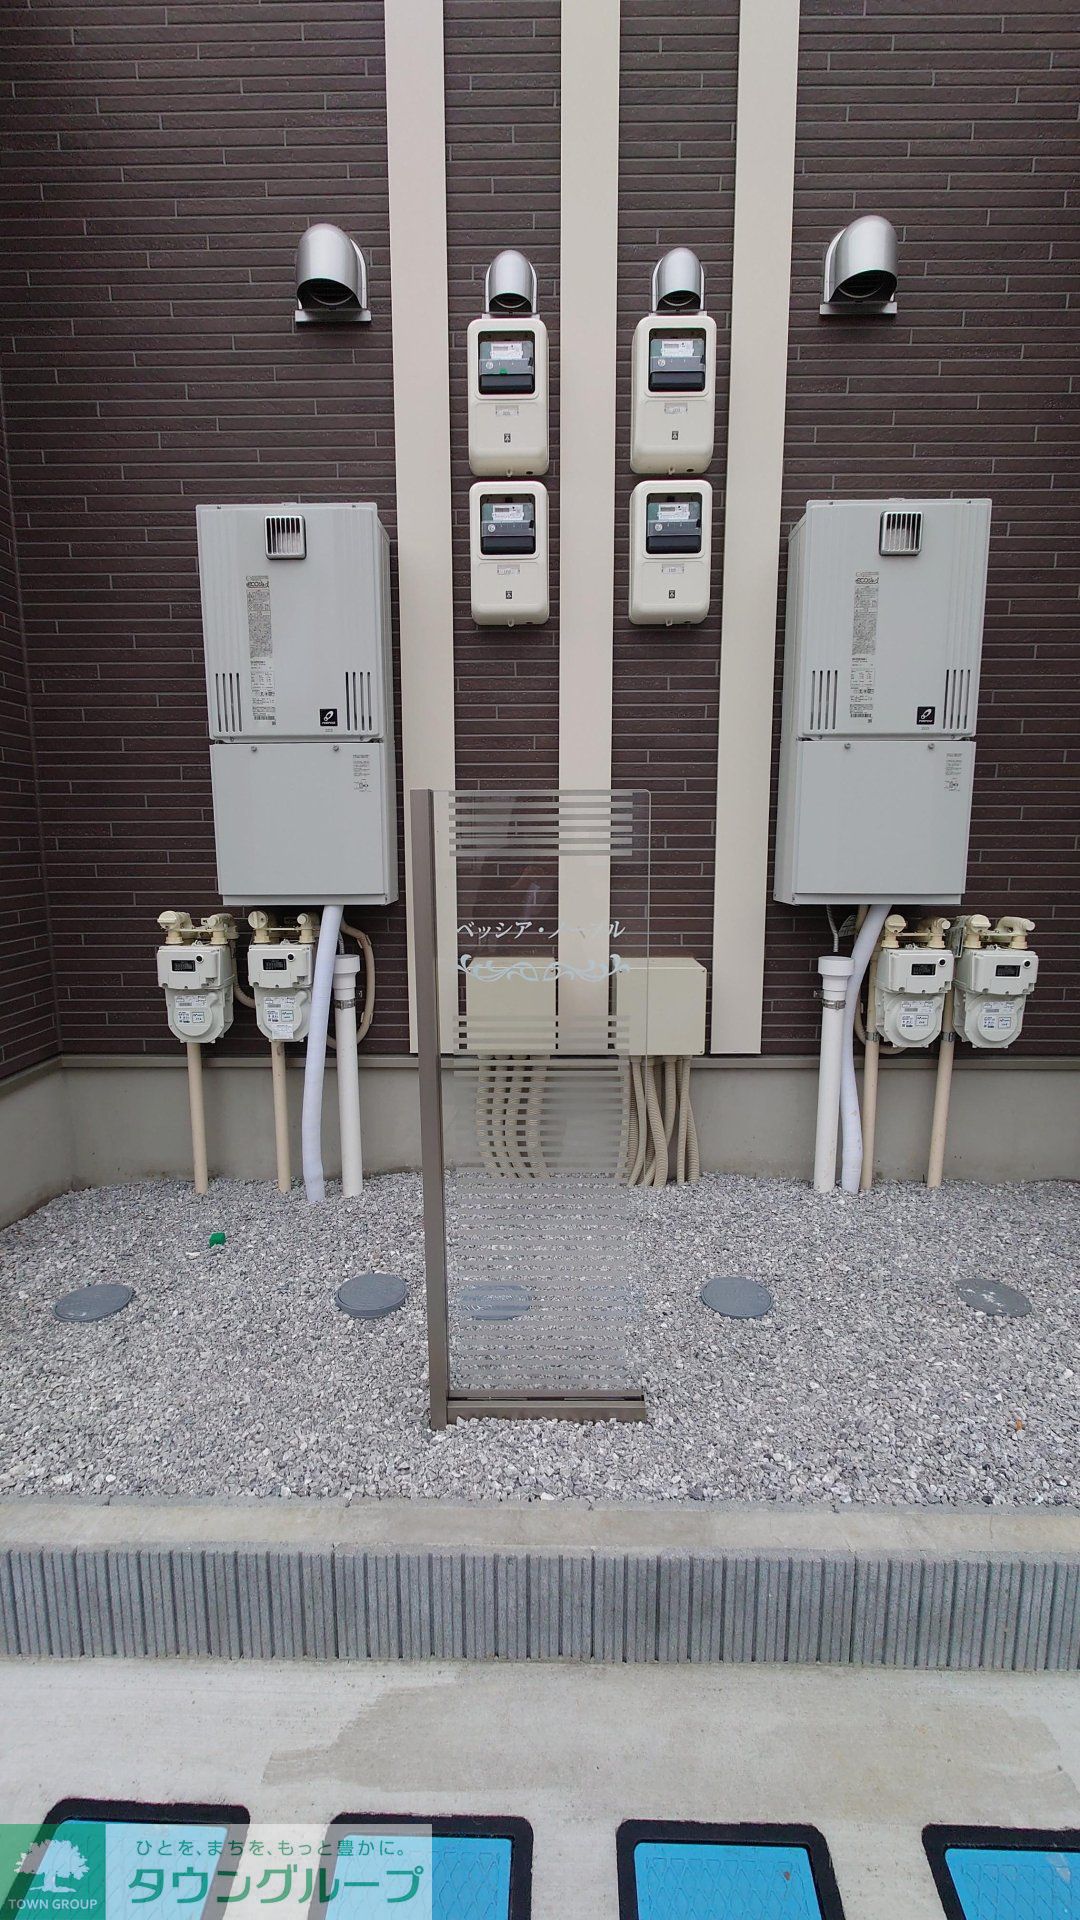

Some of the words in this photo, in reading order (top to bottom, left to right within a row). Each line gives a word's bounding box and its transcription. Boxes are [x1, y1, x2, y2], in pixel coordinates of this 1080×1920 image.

[456, 920, 626, 939] ベッシア・ノル
